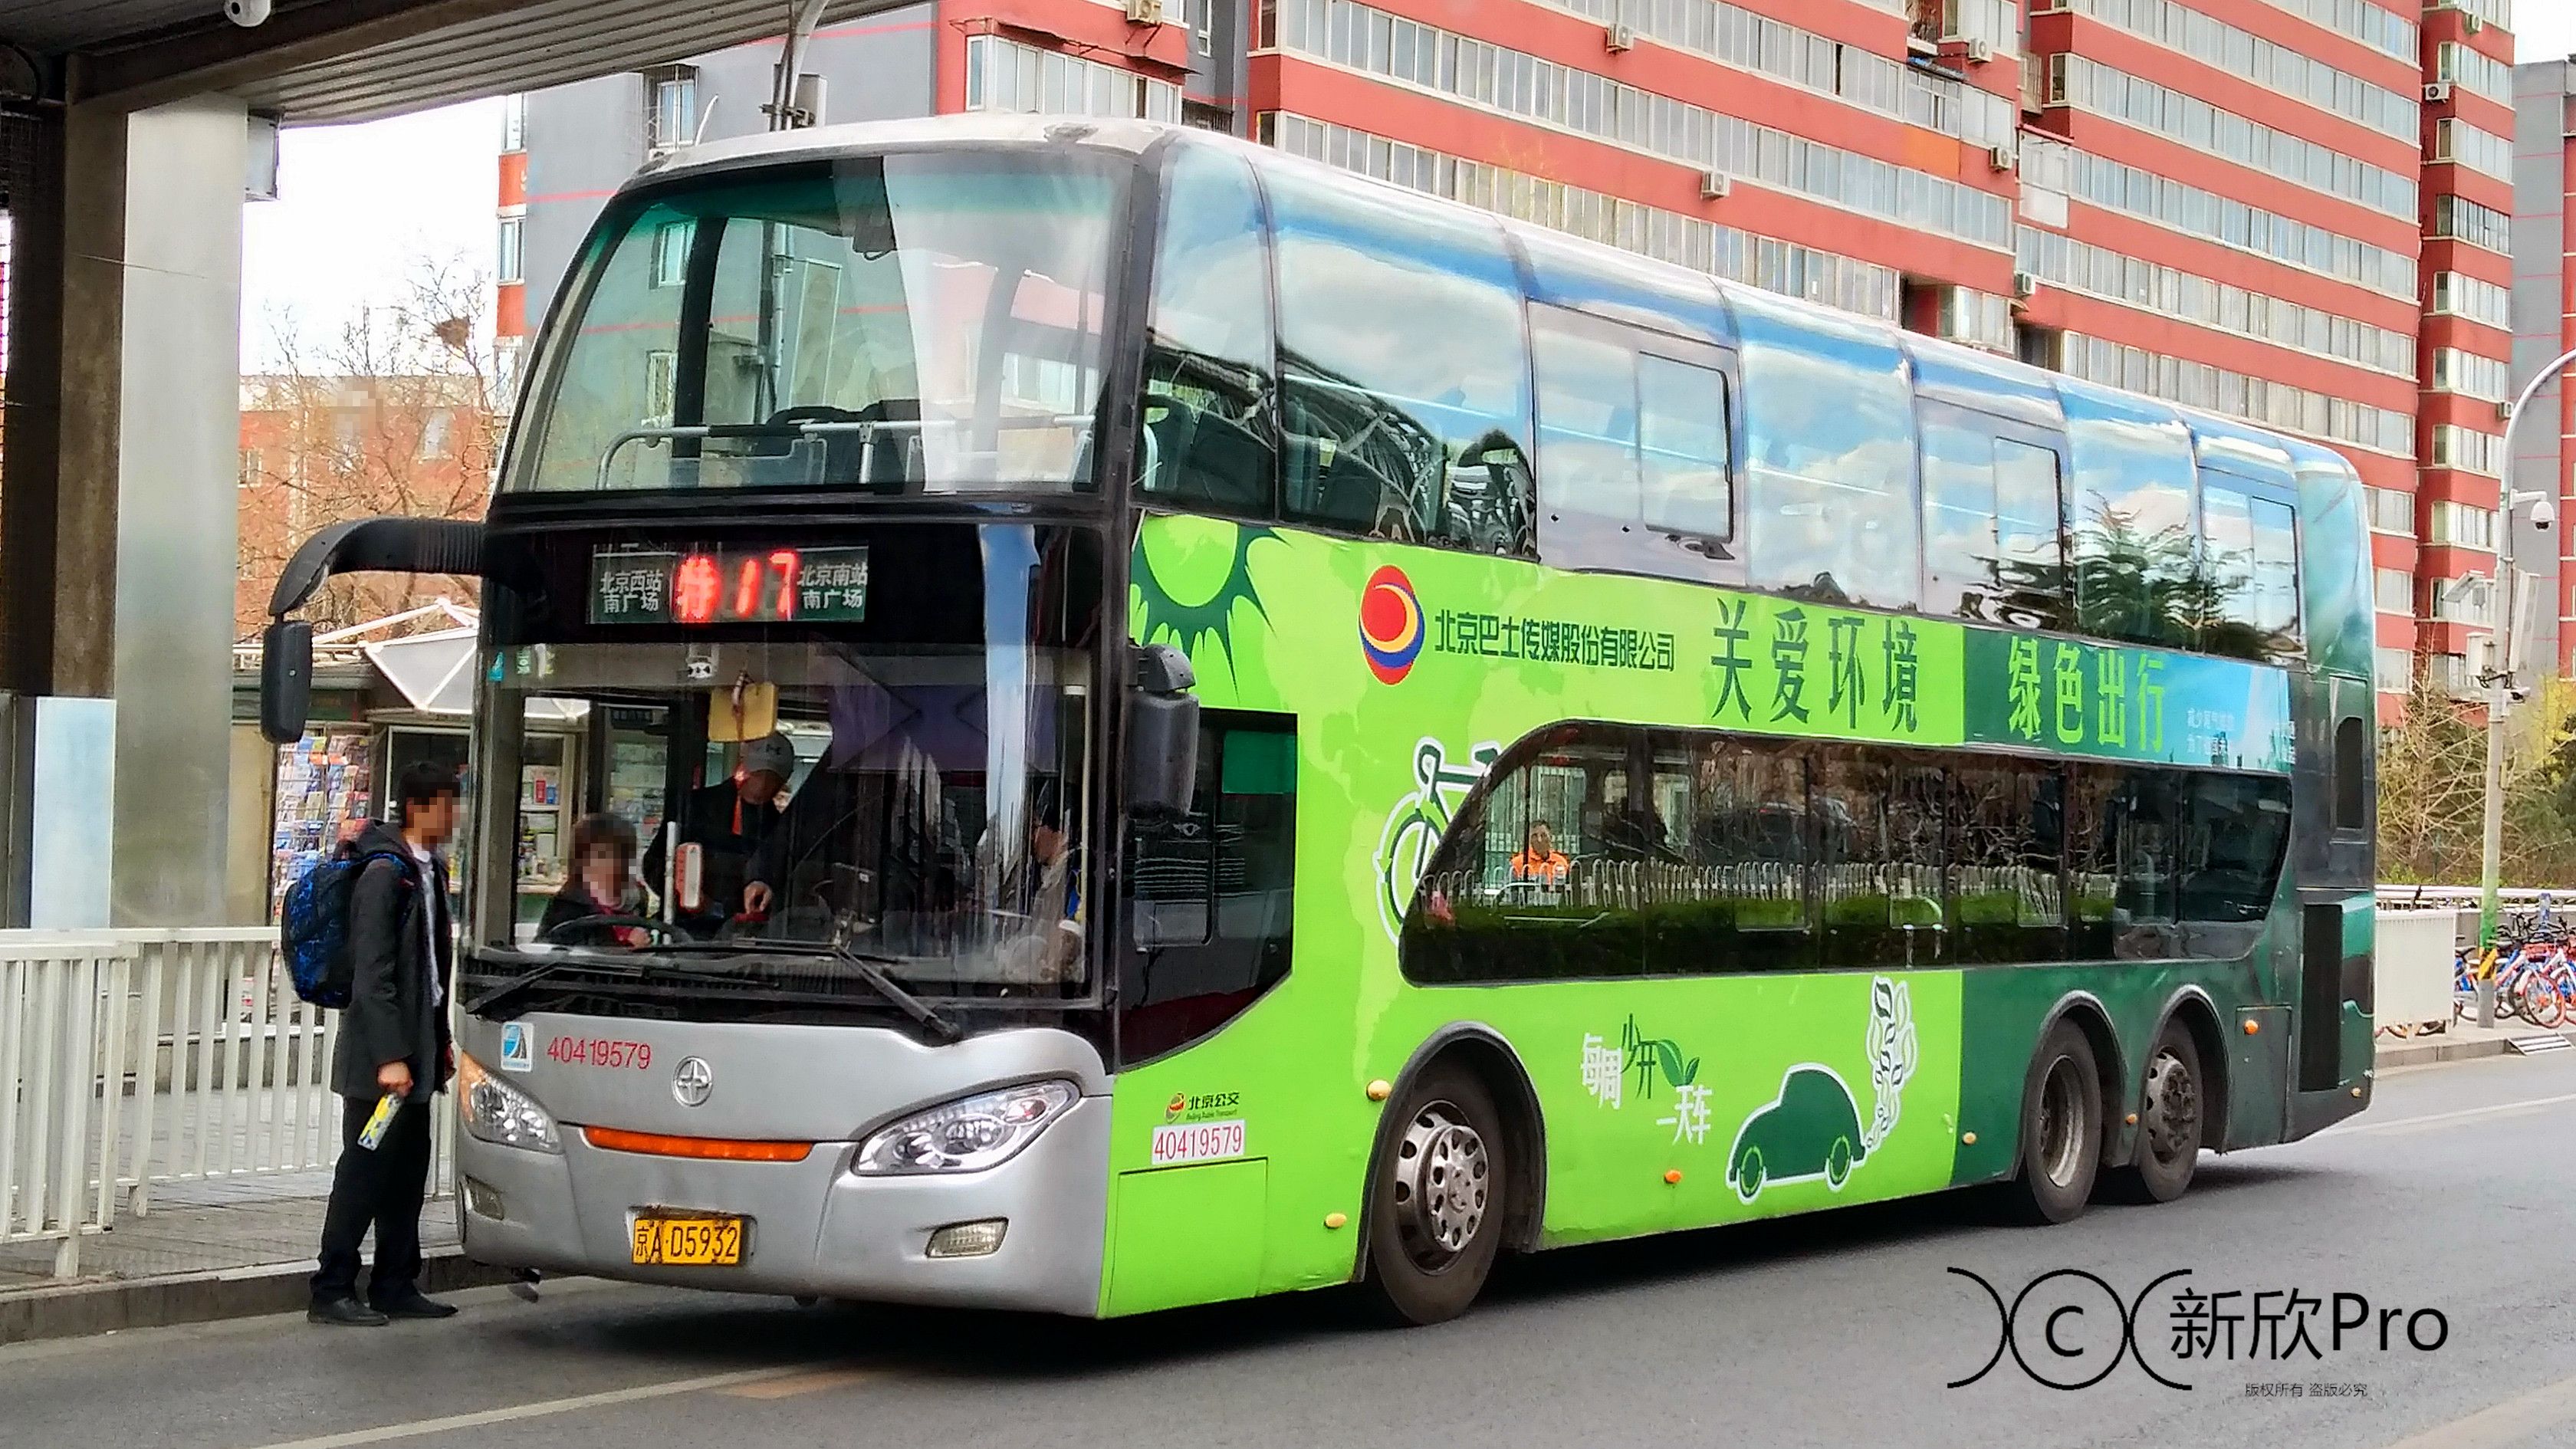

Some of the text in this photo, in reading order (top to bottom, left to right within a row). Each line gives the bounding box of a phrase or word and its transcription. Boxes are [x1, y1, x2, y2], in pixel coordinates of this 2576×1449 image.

[600, 570, 662, 593] 北京西站
[797, 562, 868, 586] 北京南站
[603, 591, 659, 613] 南广场
[802, 588, 863, 609] 南广场
[1434, 609, 1675, 672] 北京巴士传媒股份有限公司
[1710, 597, 1919, 733] 关爱环境
[2006, 636, 2166, 754] 绿色出行
[547, 1037, 652, 1070] 40419579
[1188, 1092, 1240, 1110] 北京公交
[1656, 1085, 1714, 1145] 一天车
[1155, 1125, 1242, 1160] 40419579
